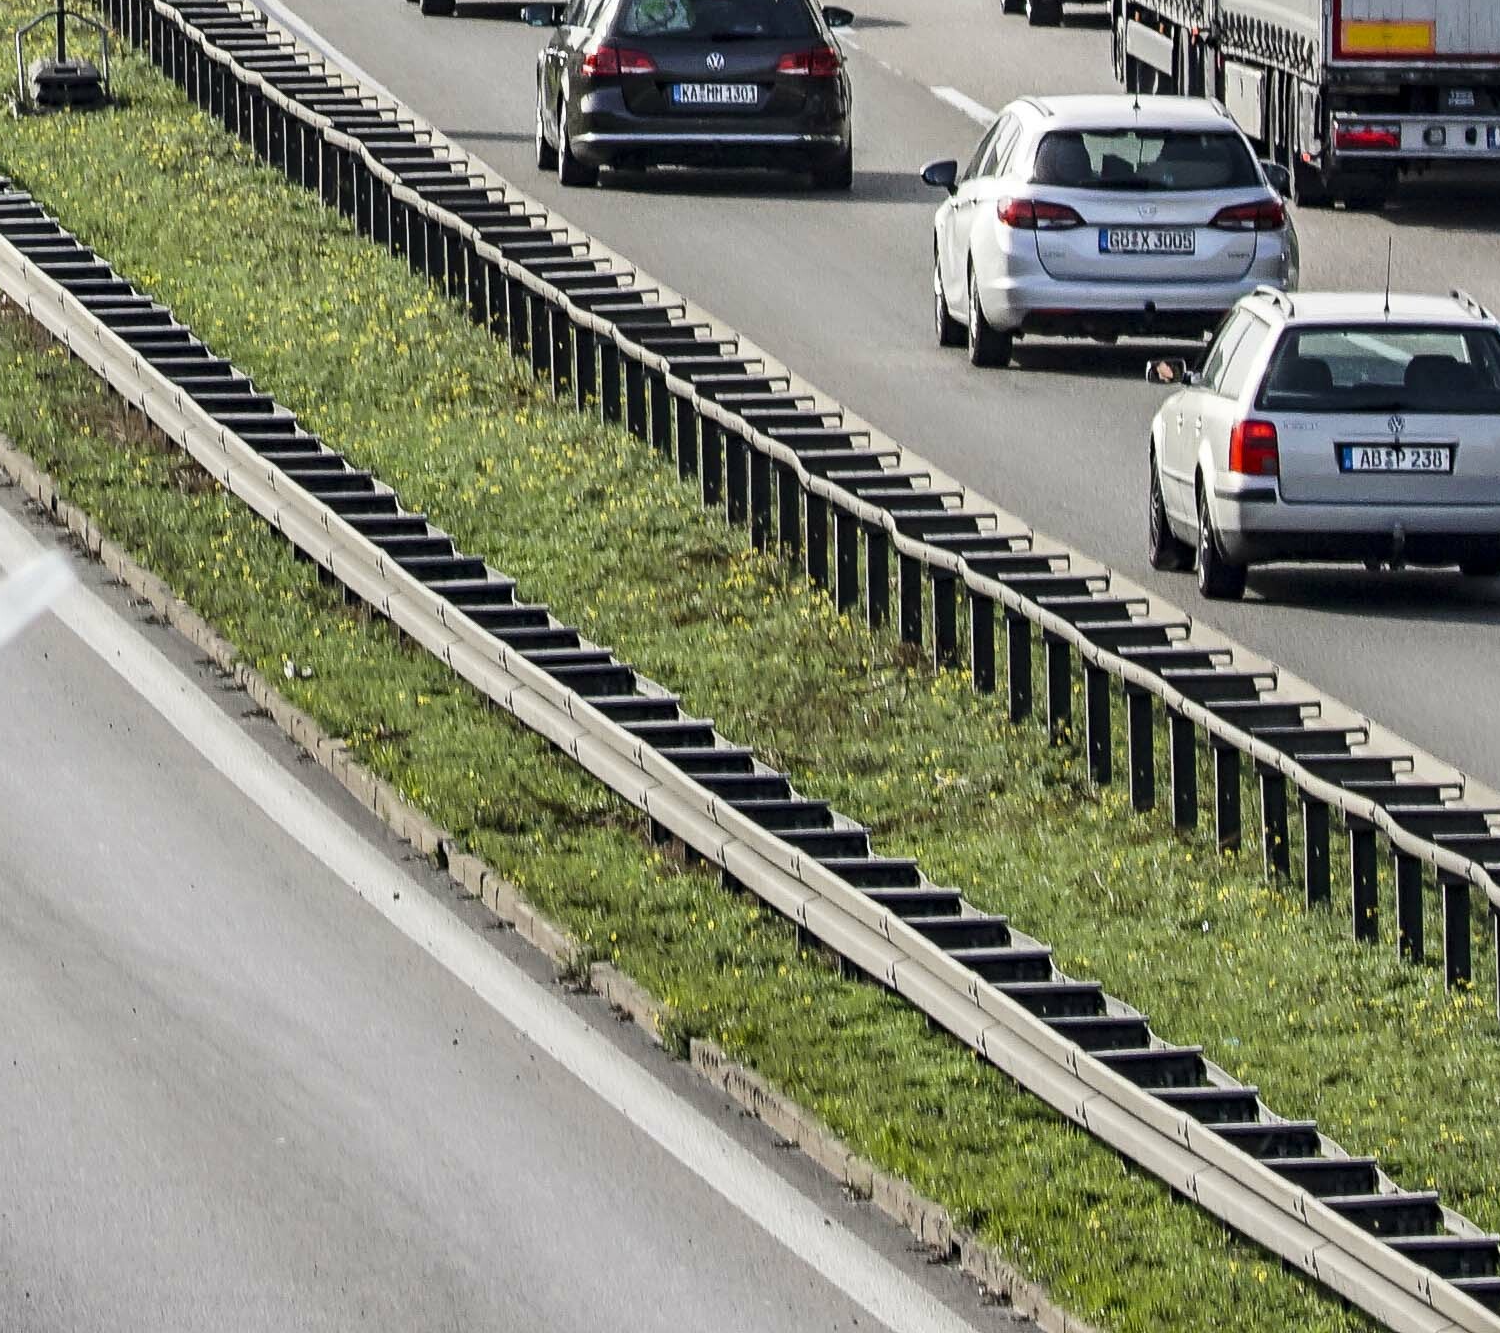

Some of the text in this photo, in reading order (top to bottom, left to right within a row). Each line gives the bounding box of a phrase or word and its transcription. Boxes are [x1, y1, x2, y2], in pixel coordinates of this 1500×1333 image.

[1141, 229, 1151, 249] X
[1360, 448, 1443, 469] AB P 238
